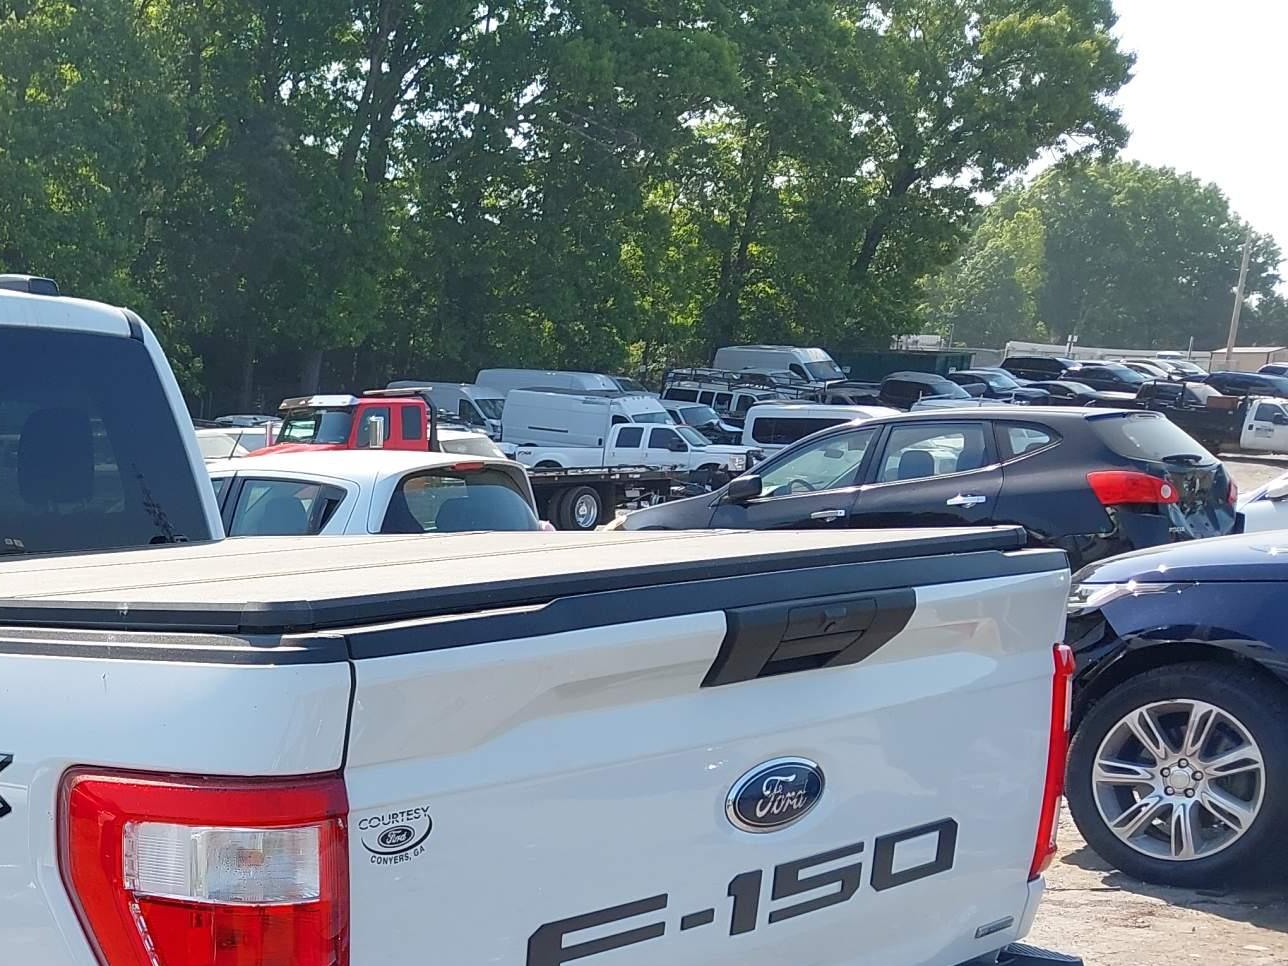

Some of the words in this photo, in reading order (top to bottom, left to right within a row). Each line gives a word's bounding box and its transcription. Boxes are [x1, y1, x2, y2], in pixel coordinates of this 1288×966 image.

[756, 773, 808, 818] Ford
[358, 805, 430, 830] COURTESY
[370, 853, 412, 865] CONYERS,
[413, 845, 425, 857] GA
